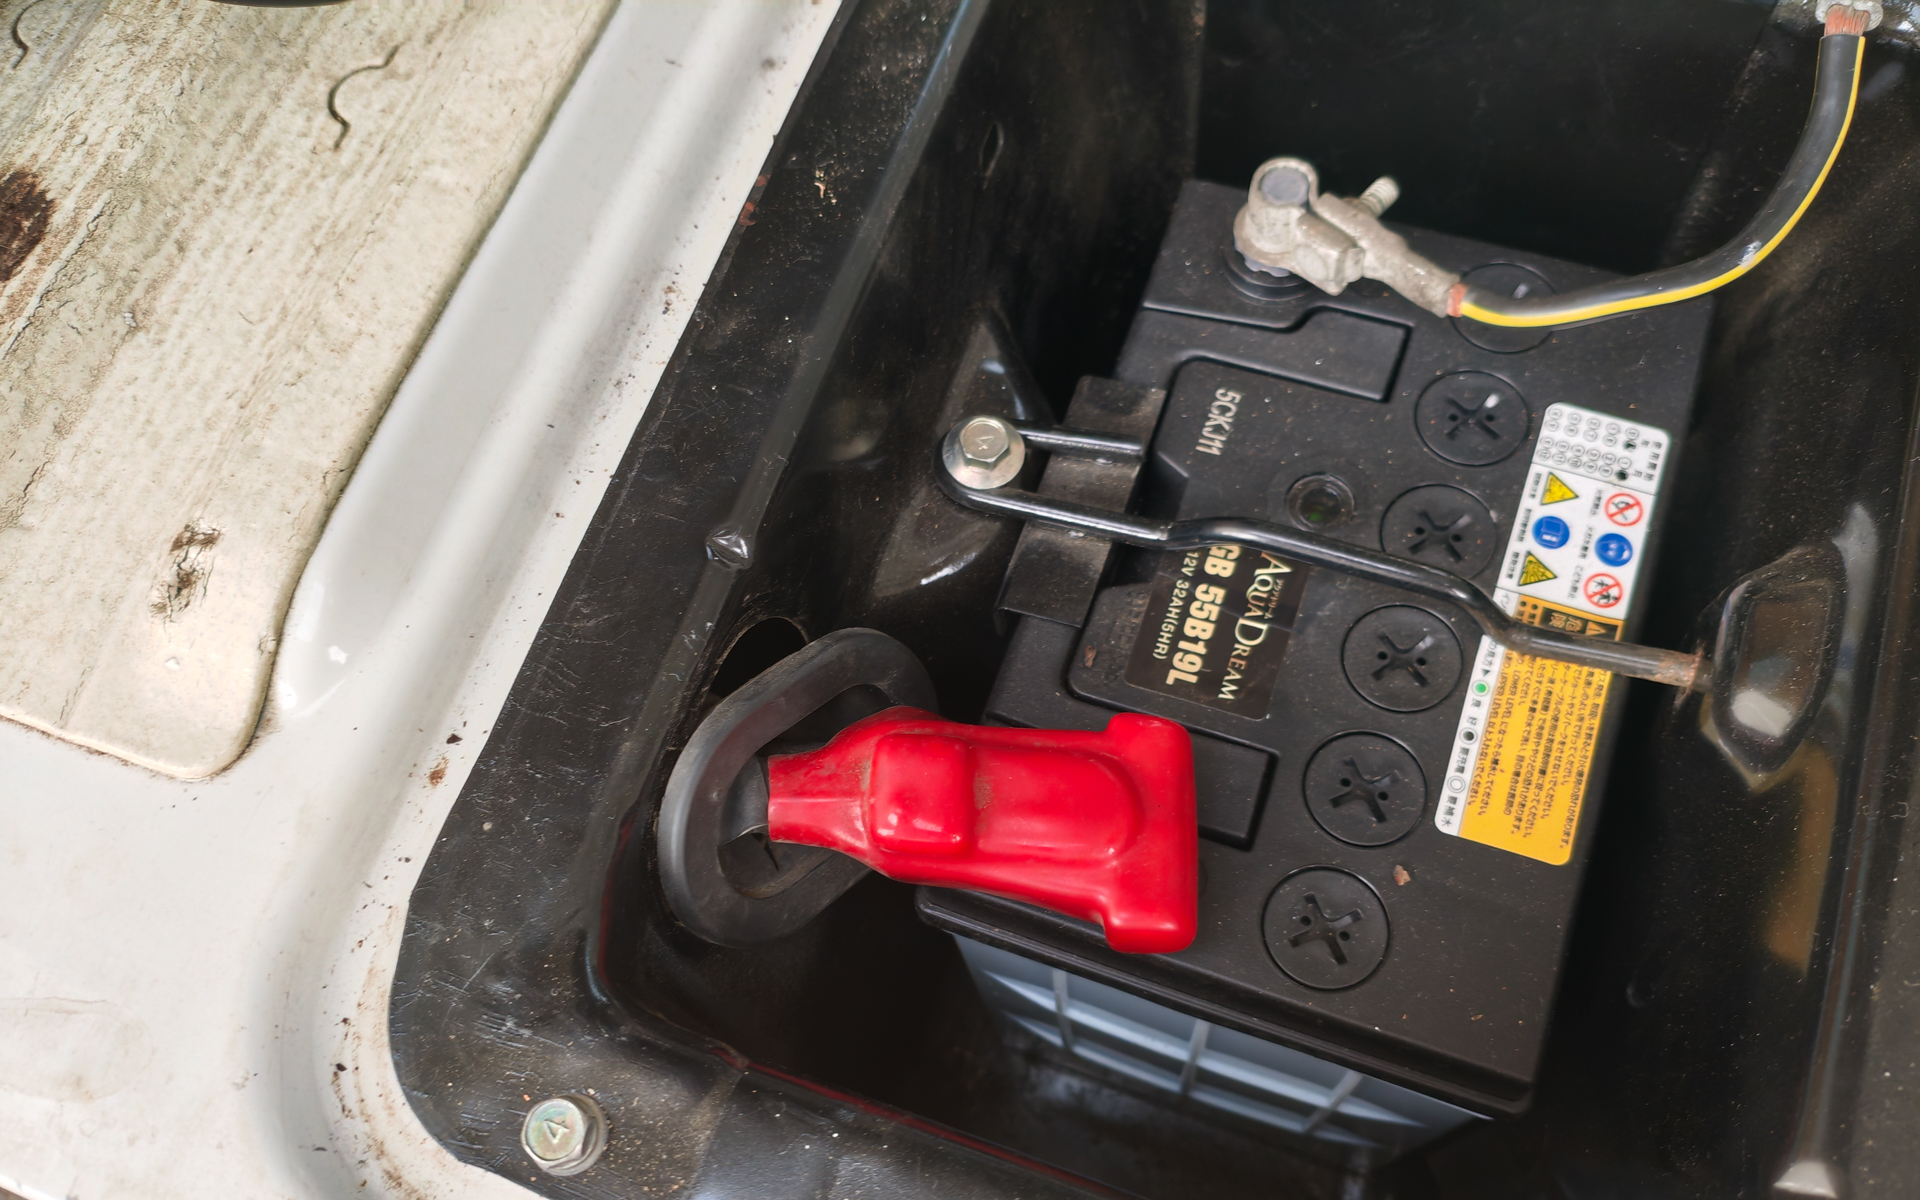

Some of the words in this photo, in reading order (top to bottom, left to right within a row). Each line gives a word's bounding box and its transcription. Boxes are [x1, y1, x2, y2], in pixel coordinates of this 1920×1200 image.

[1195, 388, 1241, 456] 5CKJ11
[1181, 551, 1199, 577] 12V
[1204, 545, 1241, 578] GB
[1152, 579, 1190, 660] 32AH(5HR)
[1165, 583, 1227, 686] 55B19L
